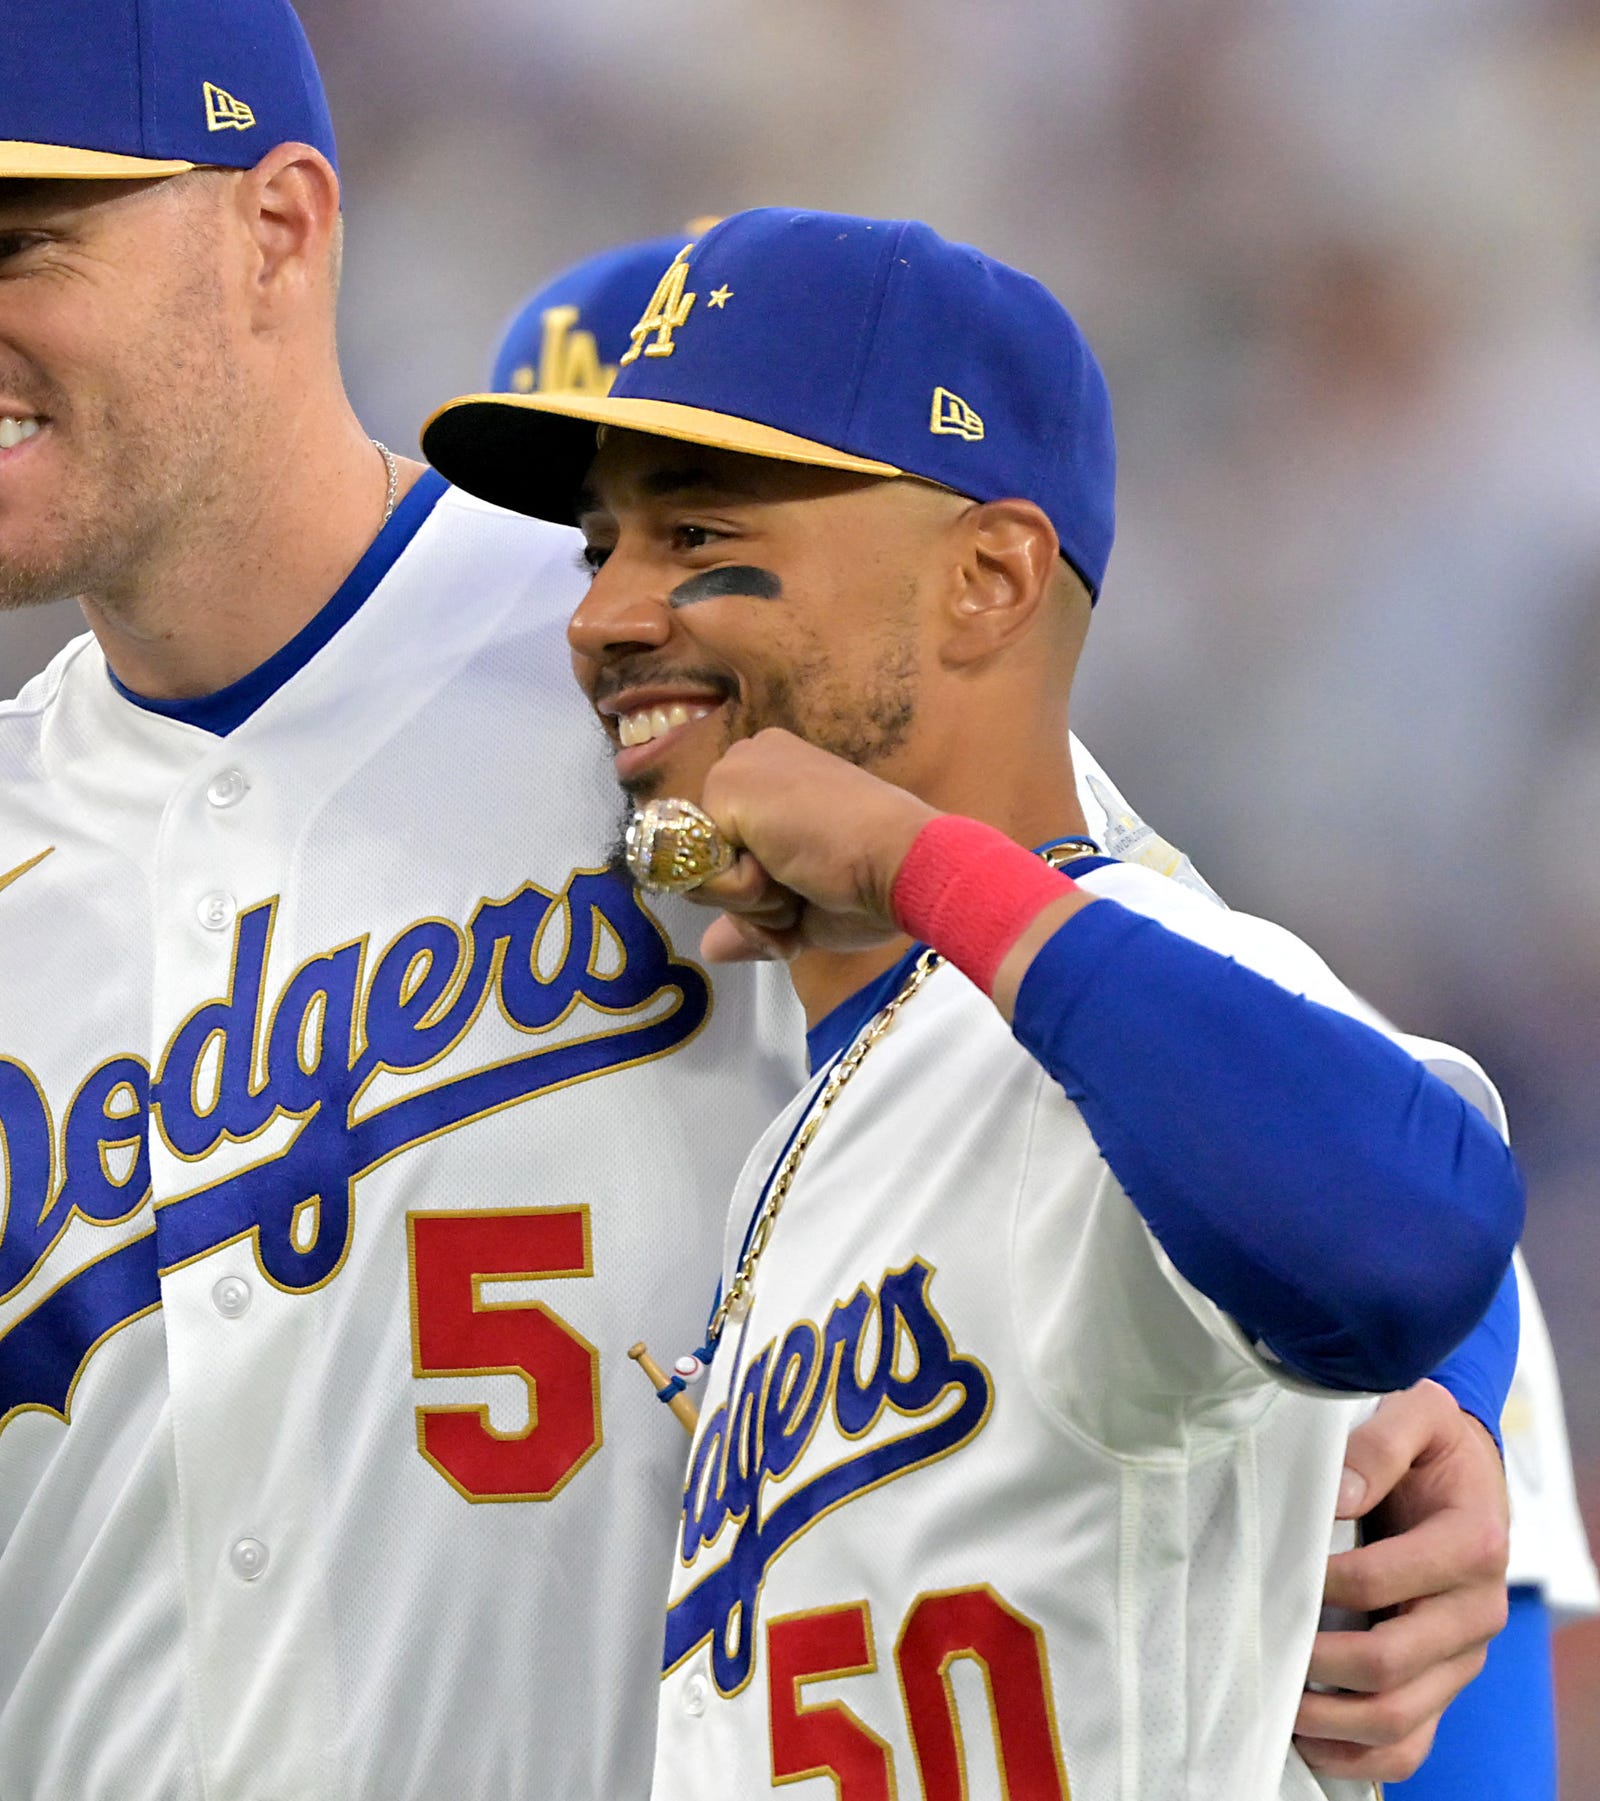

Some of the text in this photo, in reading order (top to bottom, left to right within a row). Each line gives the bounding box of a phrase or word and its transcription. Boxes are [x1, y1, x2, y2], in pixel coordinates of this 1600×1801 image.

[620, 243, 696, 366] LA
[405, 1203, 602, 1503] 5
[680, 1255, 994, 1699] dgers
[766, 1582, 1072, 1801] 50
